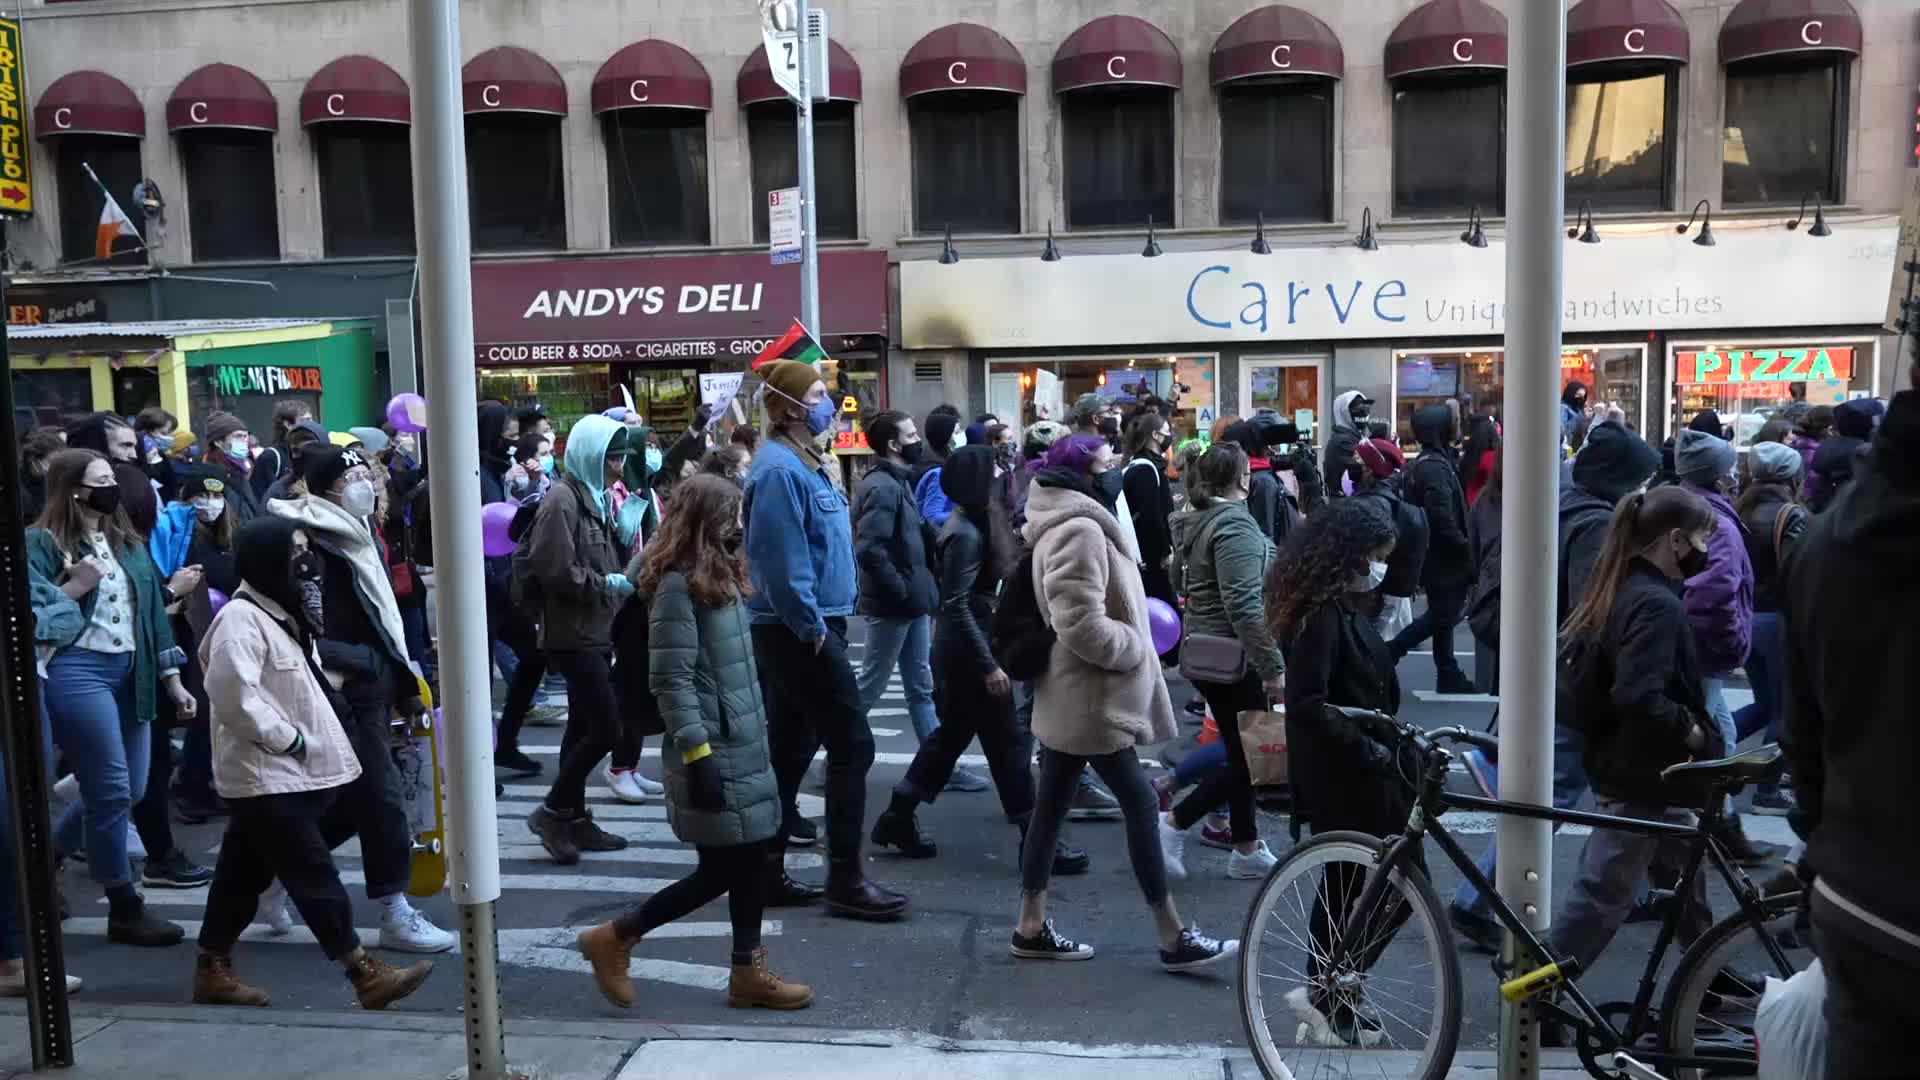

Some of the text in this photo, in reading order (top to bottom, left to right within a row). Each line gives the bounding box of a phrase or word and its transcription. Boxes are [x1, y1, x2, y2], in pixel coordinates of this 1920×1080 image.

[1623, 28, 1645, 53] C
[1801, 20, 1823, 45] C
[1271, 45, 1291, 69] C
[1453, 38, 1473, 63] C
[948, 62, 967, 85] C
[1107, 56, 1127, 80] C
[483, 85, 501, 107] C
[630, 79, 649, 102] C
[190, 102, 208, 124] C
[327, 94, 345, 116] C
[55, 108, 72, 129] C
[523, 283, 763, 318] ANDY'S DELI
[1186, 264, 1406, 332] Carve
[1563, 287, 1723, 320] andwiches
[488, 346, 528, 361] COLD
[532, 345, 564, 360] BEER
[568, 344, 579, 359] &
[582, 343, 623, 358] SODA
[635, 341, 716, 357] CIGARETTES
[1695, 349, 1836, 383] PIZZA
[219, 365, 321, 395] MEAN FIDDLER
